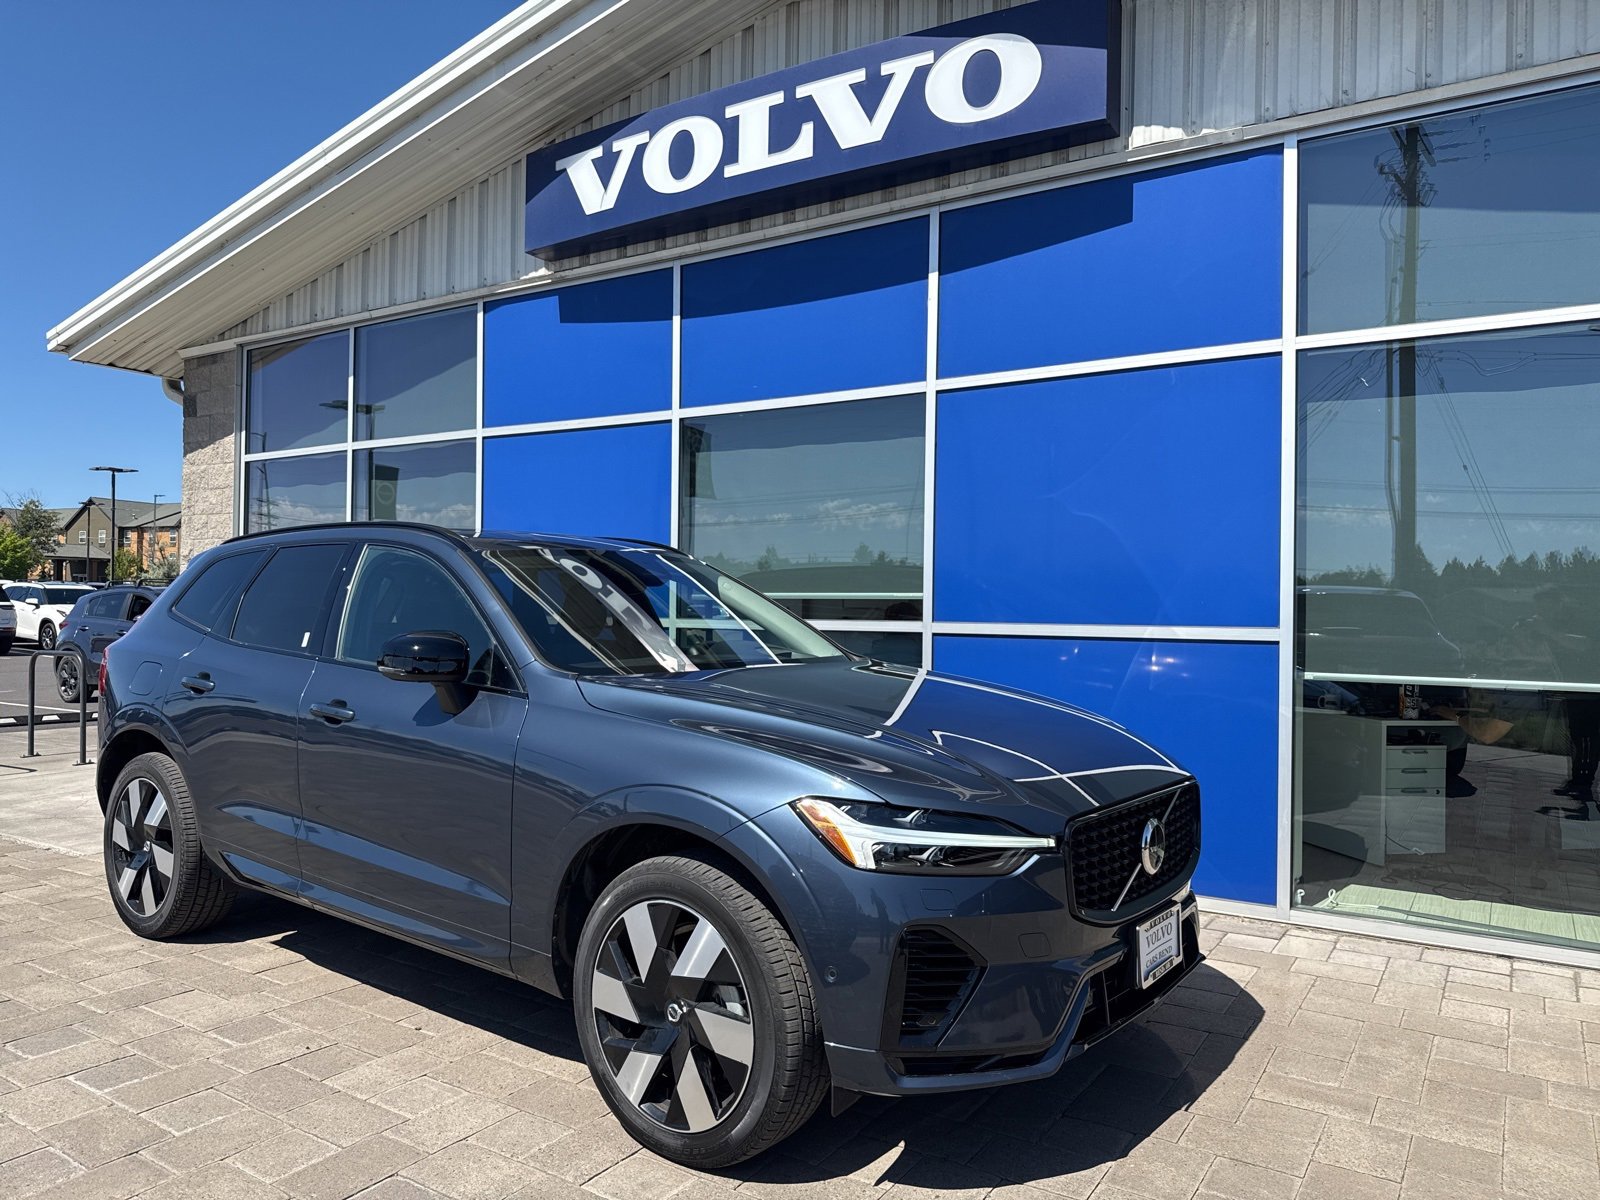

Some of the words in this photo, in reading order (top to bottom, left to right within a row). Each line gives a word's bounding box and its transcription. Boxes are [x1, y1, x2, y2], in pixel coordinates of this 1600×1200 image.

[555, 33, 1043, 216] VOLVO
[1146, 922, 1172, 948] VOLVO
[1145, 953, 1158, 968] CARS
[1158, 945, 1173, 960] BEND
